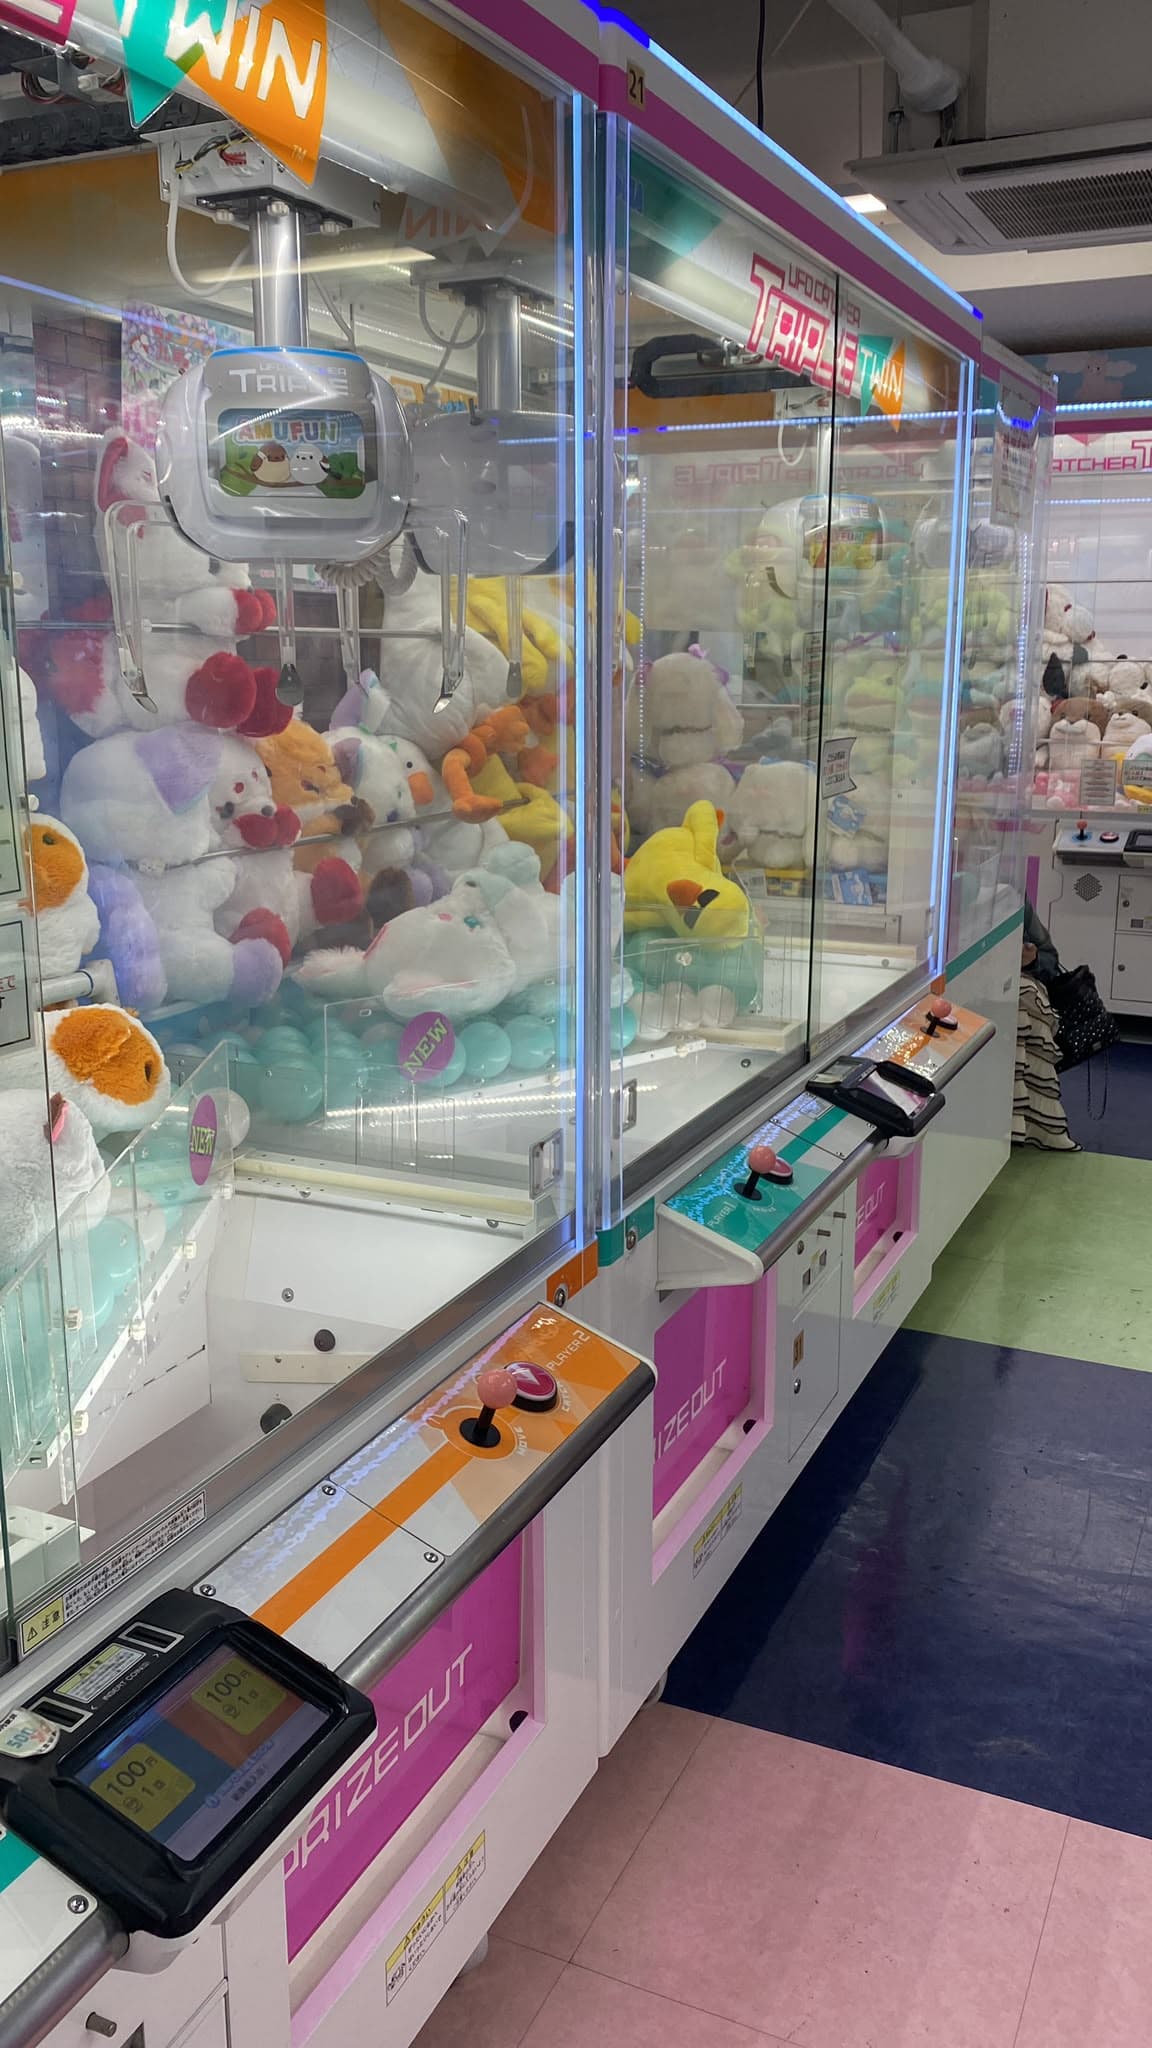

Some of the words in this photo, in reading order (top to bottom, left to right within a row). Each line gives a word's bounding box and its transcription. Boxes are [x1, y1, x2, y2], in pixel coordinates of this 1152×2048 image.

[628, 69, 644, 104] 21
[747, 252, 859, 398] TRIPLE
[860, 345, 903, 402] TWIN
[239, 417, 339, 442] AMUFUN
[1052, 456, 1137, 473] ATCHER
[404, 1017, 448, 1077] NEW
[190, 1125, 216, 1156] NEW
